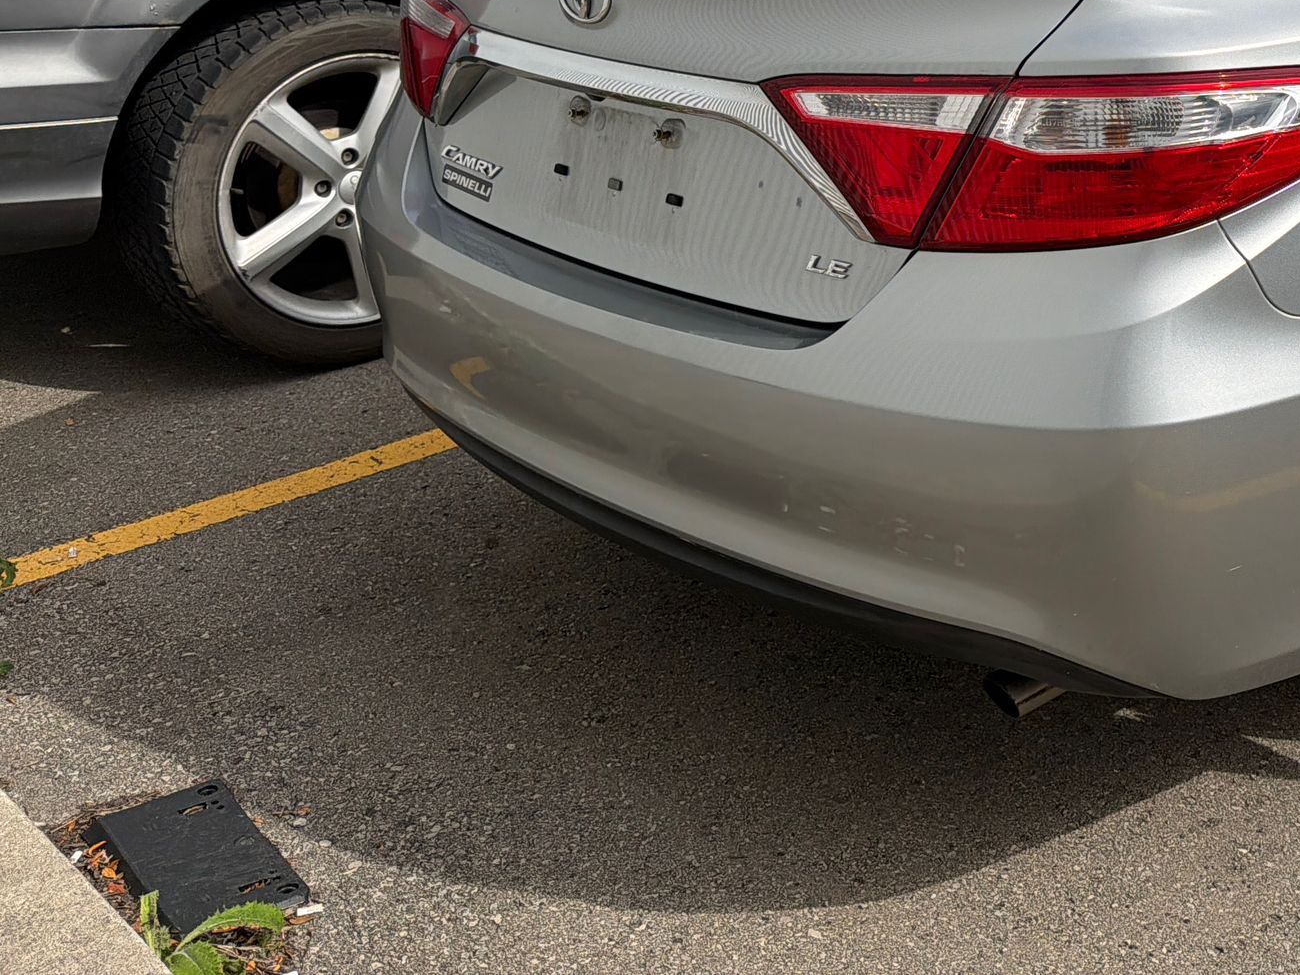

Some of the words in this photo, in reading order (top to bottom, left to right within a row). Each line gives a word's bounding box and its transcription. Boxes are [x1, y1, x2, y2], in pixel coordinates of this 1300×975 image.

[441, 144, 503, 179] CAMRY
[443, 168, 492, 198] SPINELLI
[805, 254, 853, 279] LE
